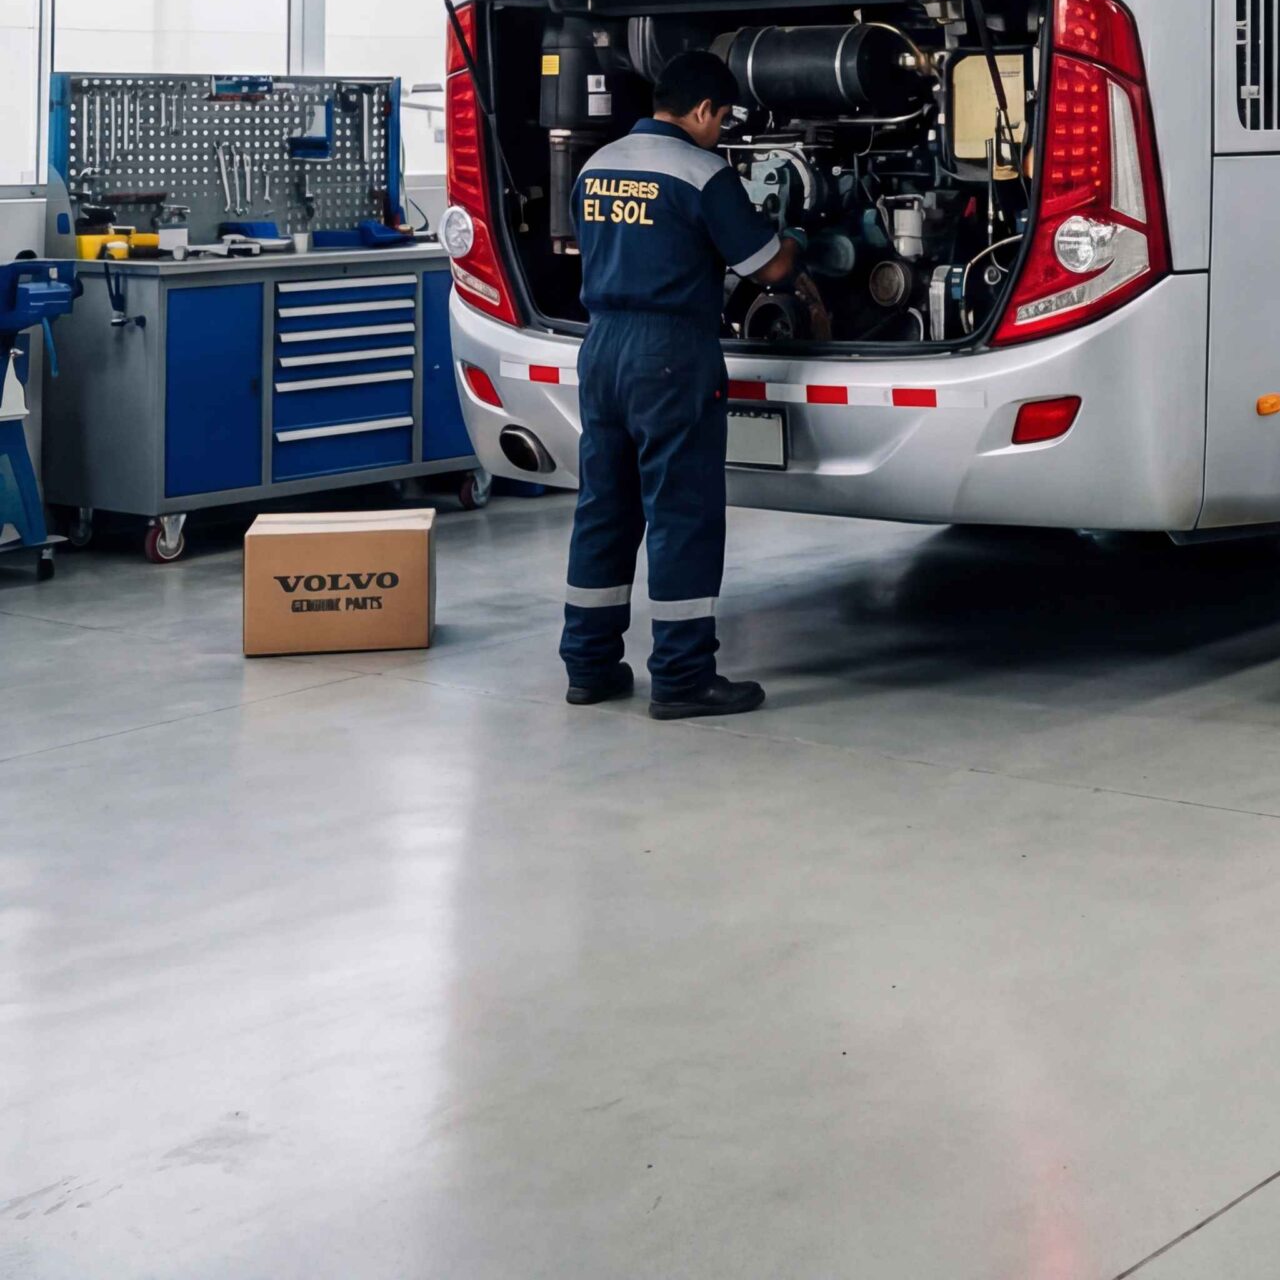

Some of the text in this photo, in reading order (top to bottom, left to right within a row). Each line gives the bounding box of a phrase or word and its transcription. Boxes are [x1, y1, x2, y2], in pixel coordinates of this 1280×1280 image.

[584, 178, 659, 200] TALLERES
[584, 199, 654, 225] EL SOL
[273, 572, 399, 593] VOLVO
